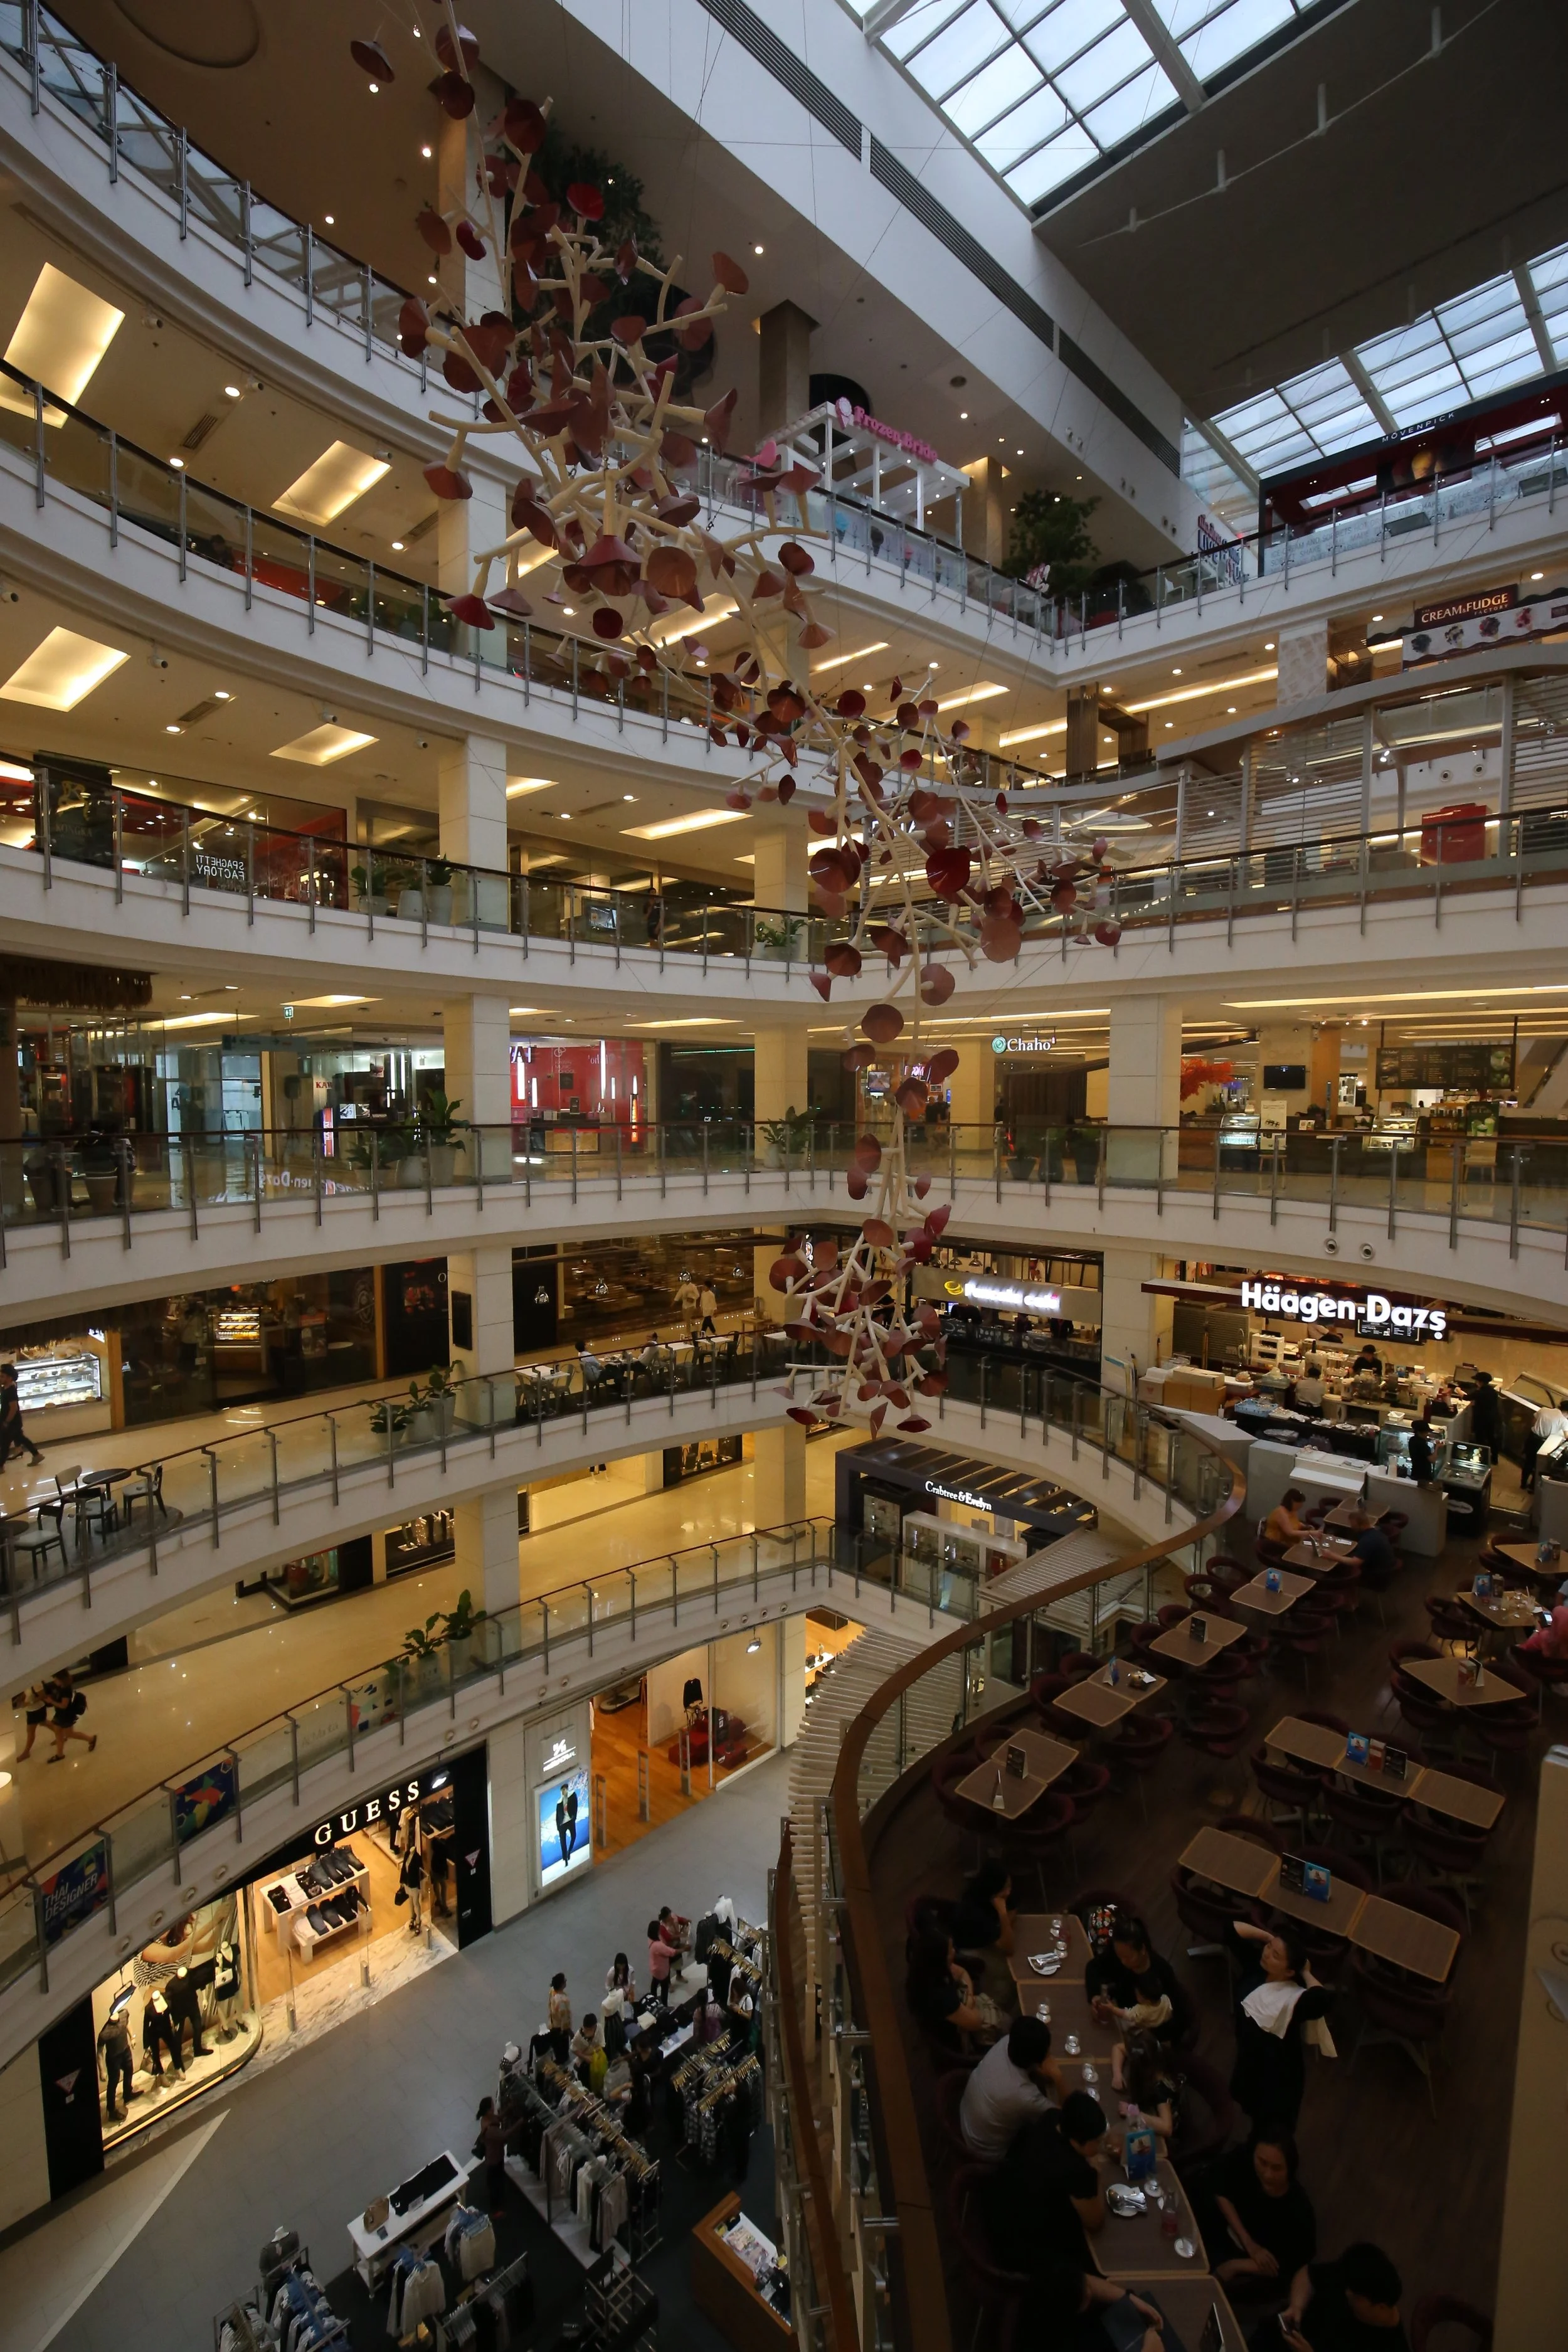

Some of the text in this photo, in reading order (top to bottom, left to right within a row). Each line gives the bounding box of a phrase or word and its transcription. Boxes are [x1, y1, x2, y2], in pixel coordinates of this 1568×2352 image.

[854, 406, 937, 463] Frozen Bride
[1475, 605, 1508, 615] FACTORY
[1241, 1281, 1446, 1331] Häagen-Dazs
[314, 1781, 420, 1845] GUESS
[45, 1882, 68, 1909] THAI
[45, 1872, 98, 1922] DESIGNER
